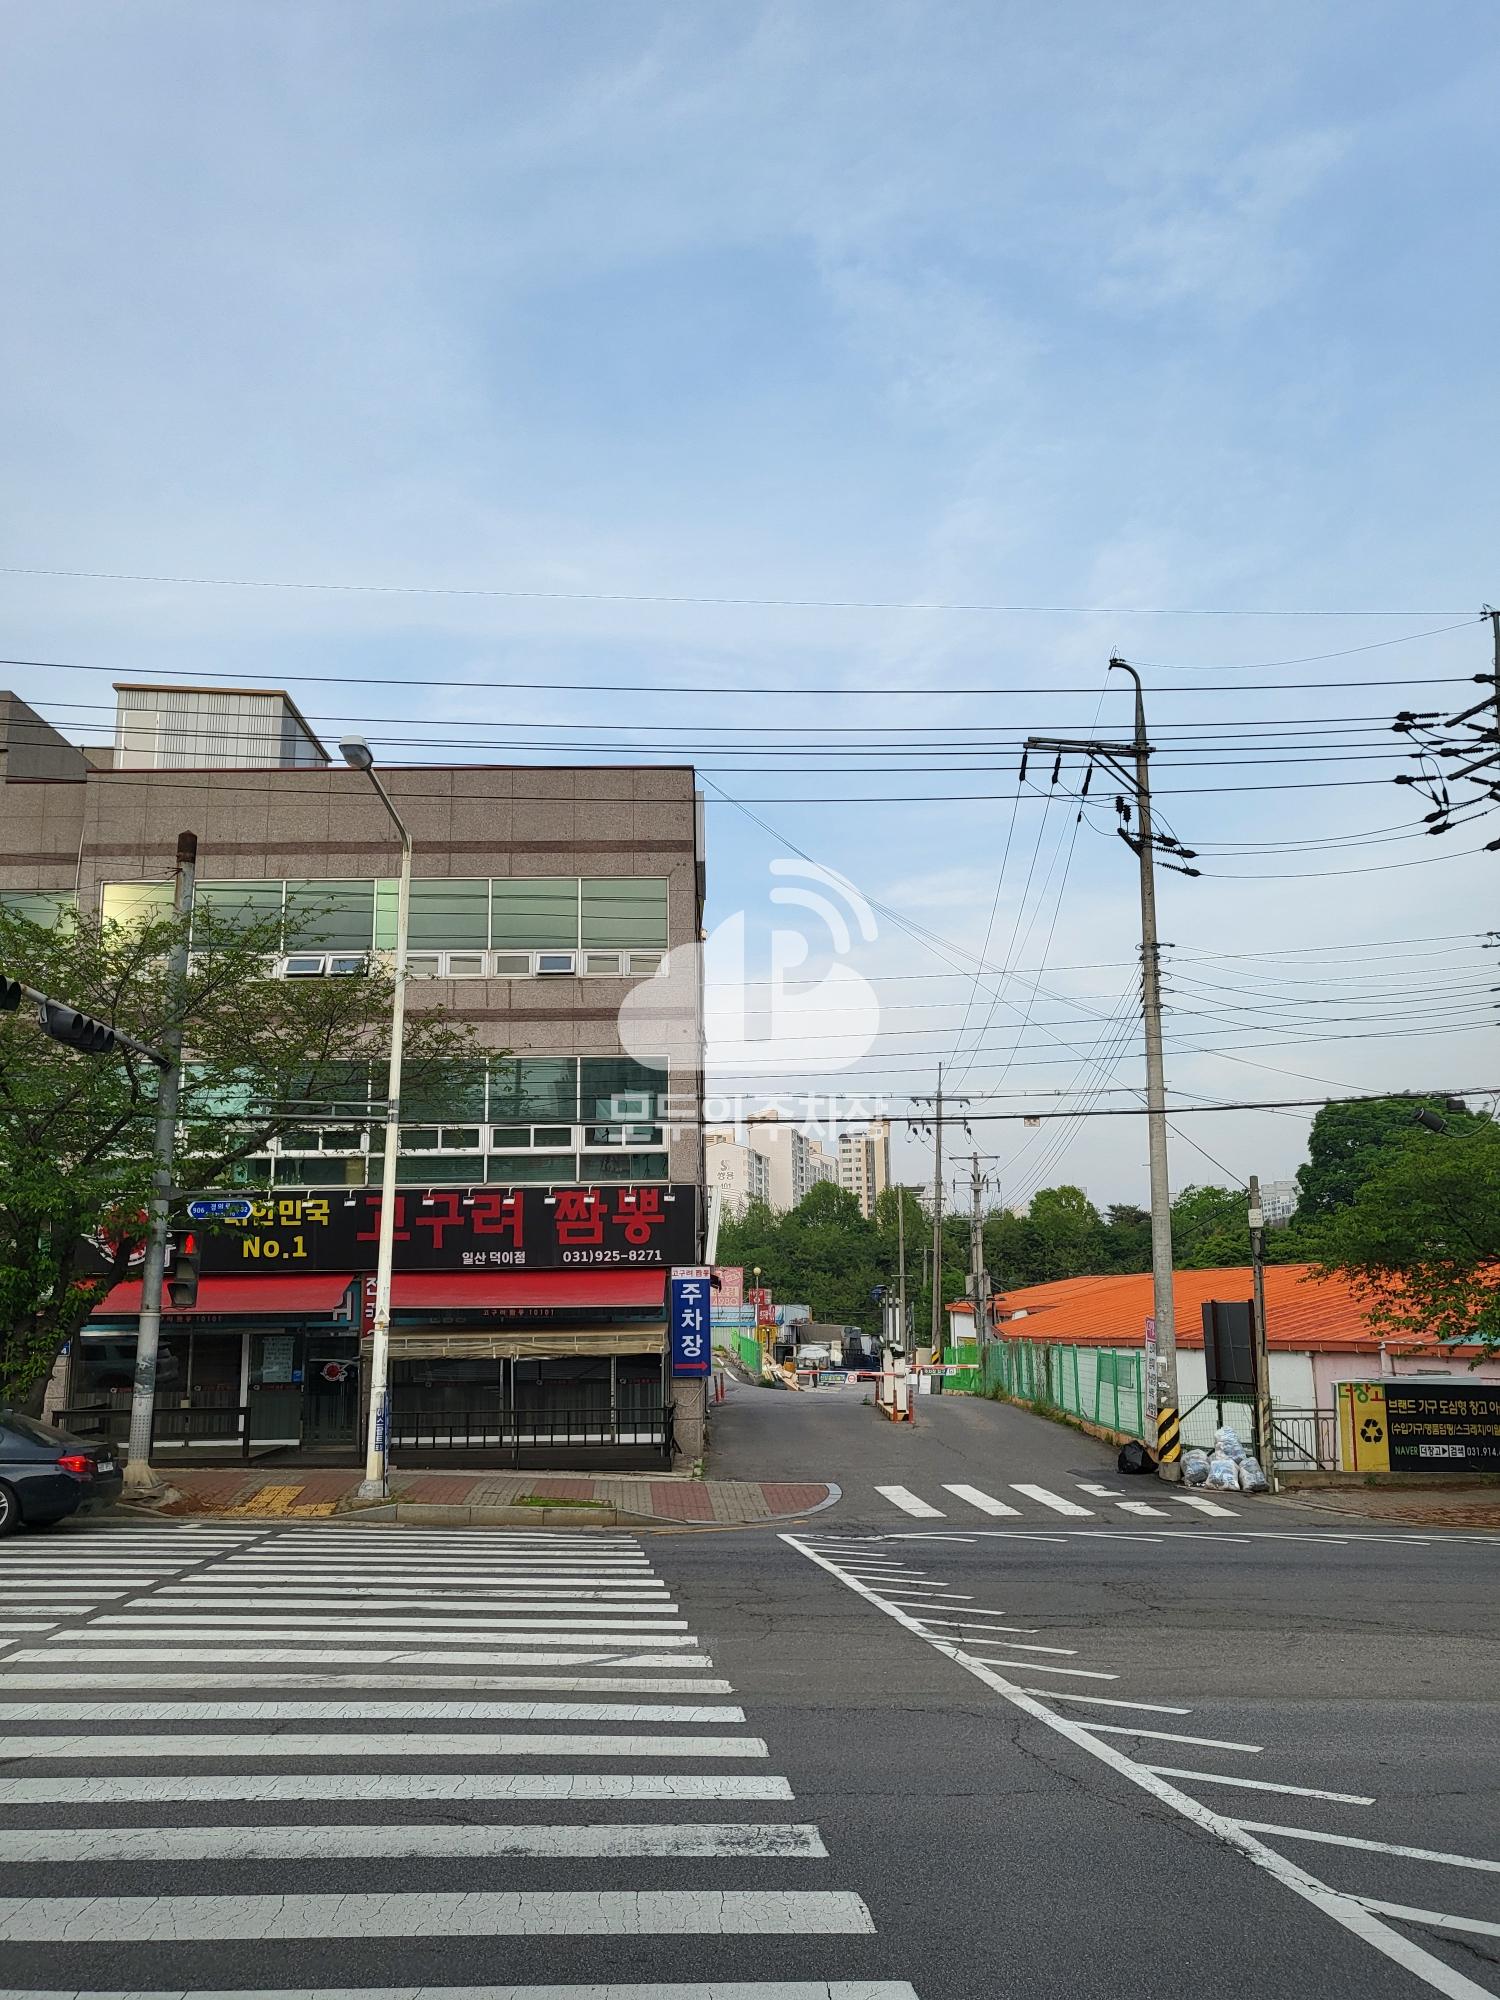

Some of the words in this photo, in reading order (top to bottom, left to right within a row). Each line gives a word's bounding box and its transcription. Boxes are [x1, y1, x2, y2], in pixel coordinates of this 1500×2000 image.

[224, 1200, 331, 1227] 한민국
[357, 1192, 524, 1249] 고구려
[554, 1189, 665, 1245] 짬뽕
[243, 1236, 308, 1259] No.1
[462, 1251, 486, 1265] 일산
[489, 1251, 526, 1264] 덕이점
[563, 1249, 662, 1263] 031)925-8271
[672, 1269, 693, 1278] 고구려
[680, 1283, 703, 1357] 주차장
[1338, 1383, 1385, 1403] 더창고
[1388, 1400, 1417, 1414] 브랜드
[1418, 1400, 1437, 1415] 가구
[1439, 1400, 1467, 1416] 도심형
[1469, 1400, 1488, 1416] 창고
[1395, 1446, 1419, 1456] NAVER
[1420, 1446, 1442, 1457] 더창고
[1450, 1446, 1466, 1457] 검색
[1466, 1447, 1500, 1457] 031.914.
